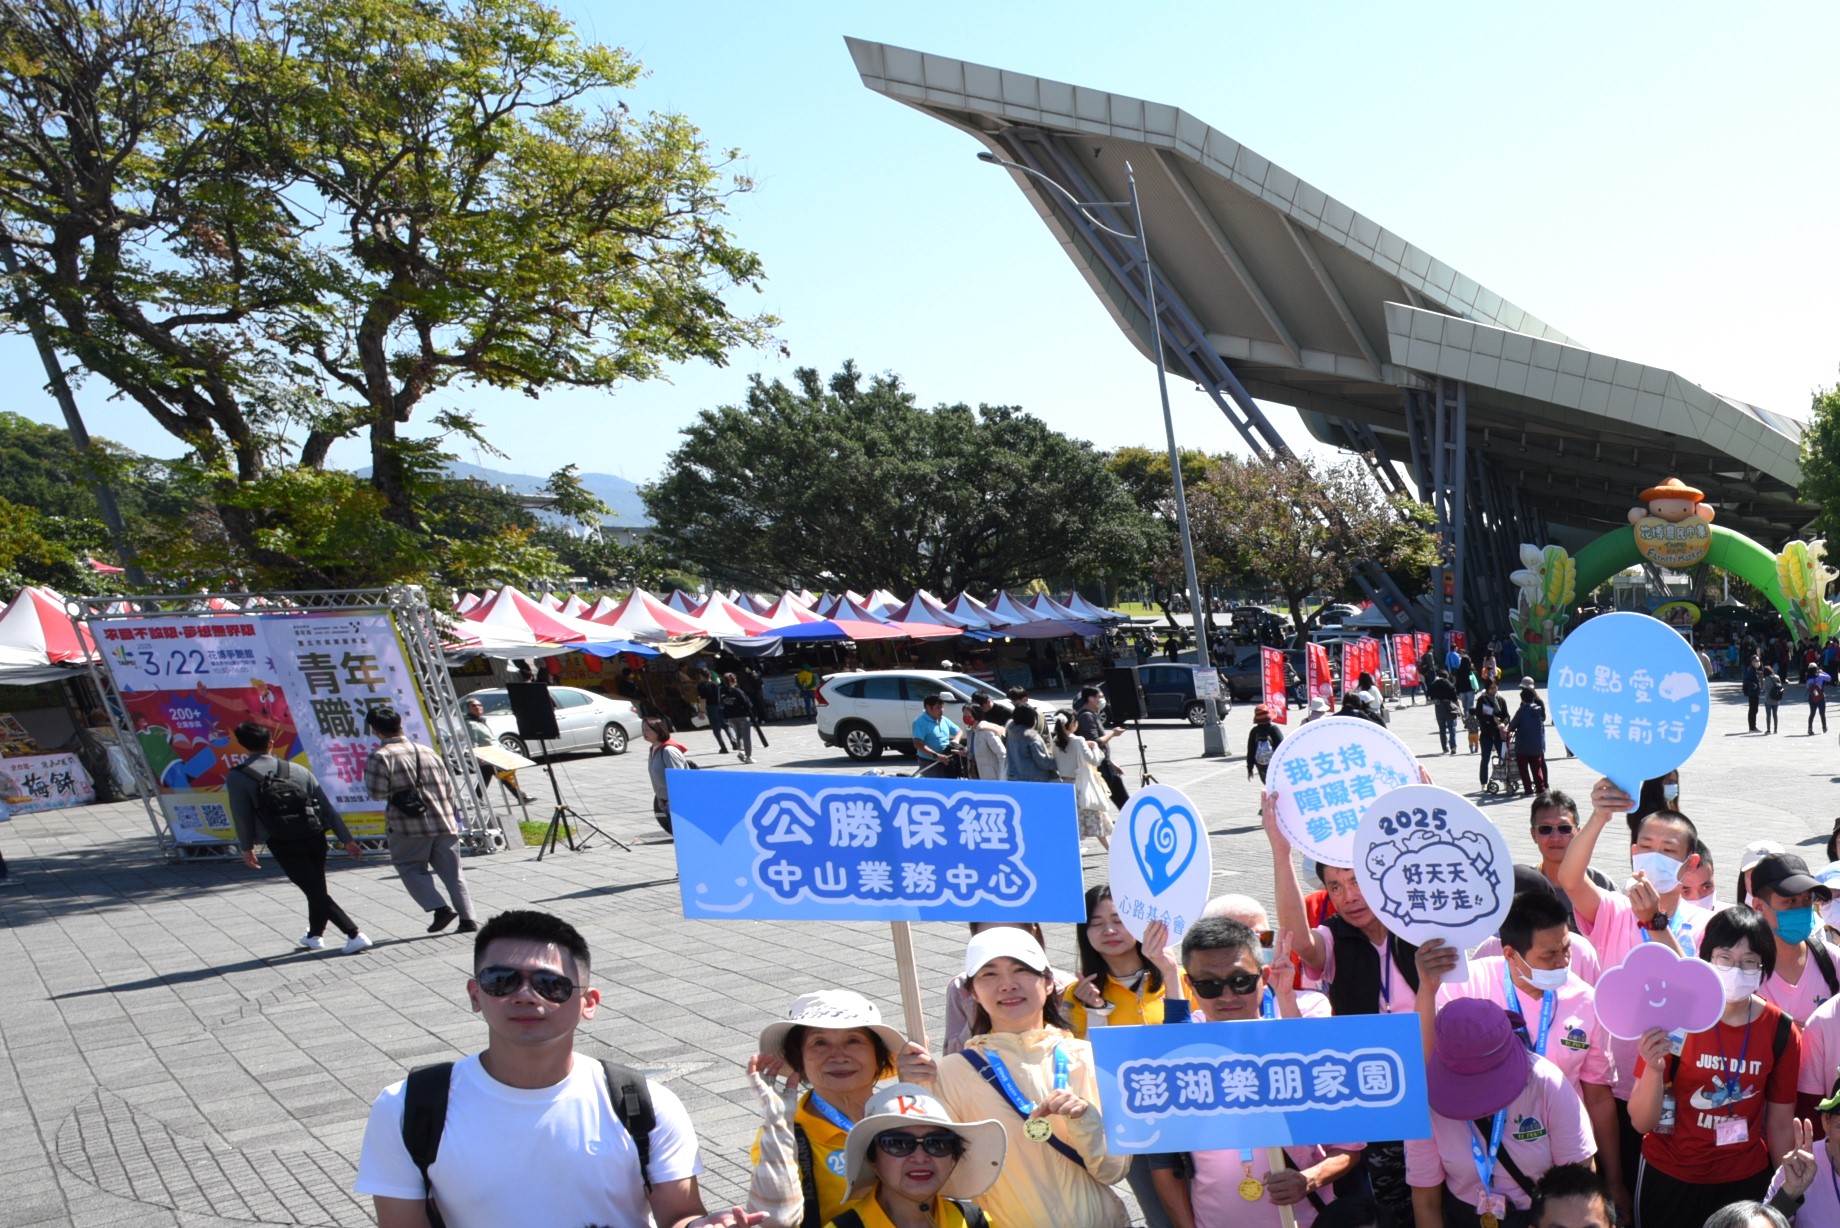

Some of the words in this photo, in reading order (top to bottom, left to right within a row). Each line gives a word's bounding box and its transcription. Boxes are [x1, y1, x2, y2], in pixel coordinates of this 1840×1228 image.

[297, 651, 387, 695] 青年
[1557, 664, 1655, 704] 加點愛
[1557, 704, 1686, 745] 微笑前行
[1283, 742, 1367, 786] 我支持
[1293, 774, 1378, 816] 障礙者
[760, 799, 1011, 850] 公勝保經
[1306, 807, 1368, 845] 參與
[1378, 808, 1449, 836] 2025
[767, 859, 1023, 895] 中山業務中心
[1402, 862, 1469, 886] 好天天
[1118, 895, 1186, 936] 心路基金會
[1130, 1060, 1393, 1106] 澎湖樂朋家園
[1696, 1053, 1728, 1071] JUST
[1729, 1058, 1747, 1074] DO
[1749, 1061, 1762, 1075] IT
